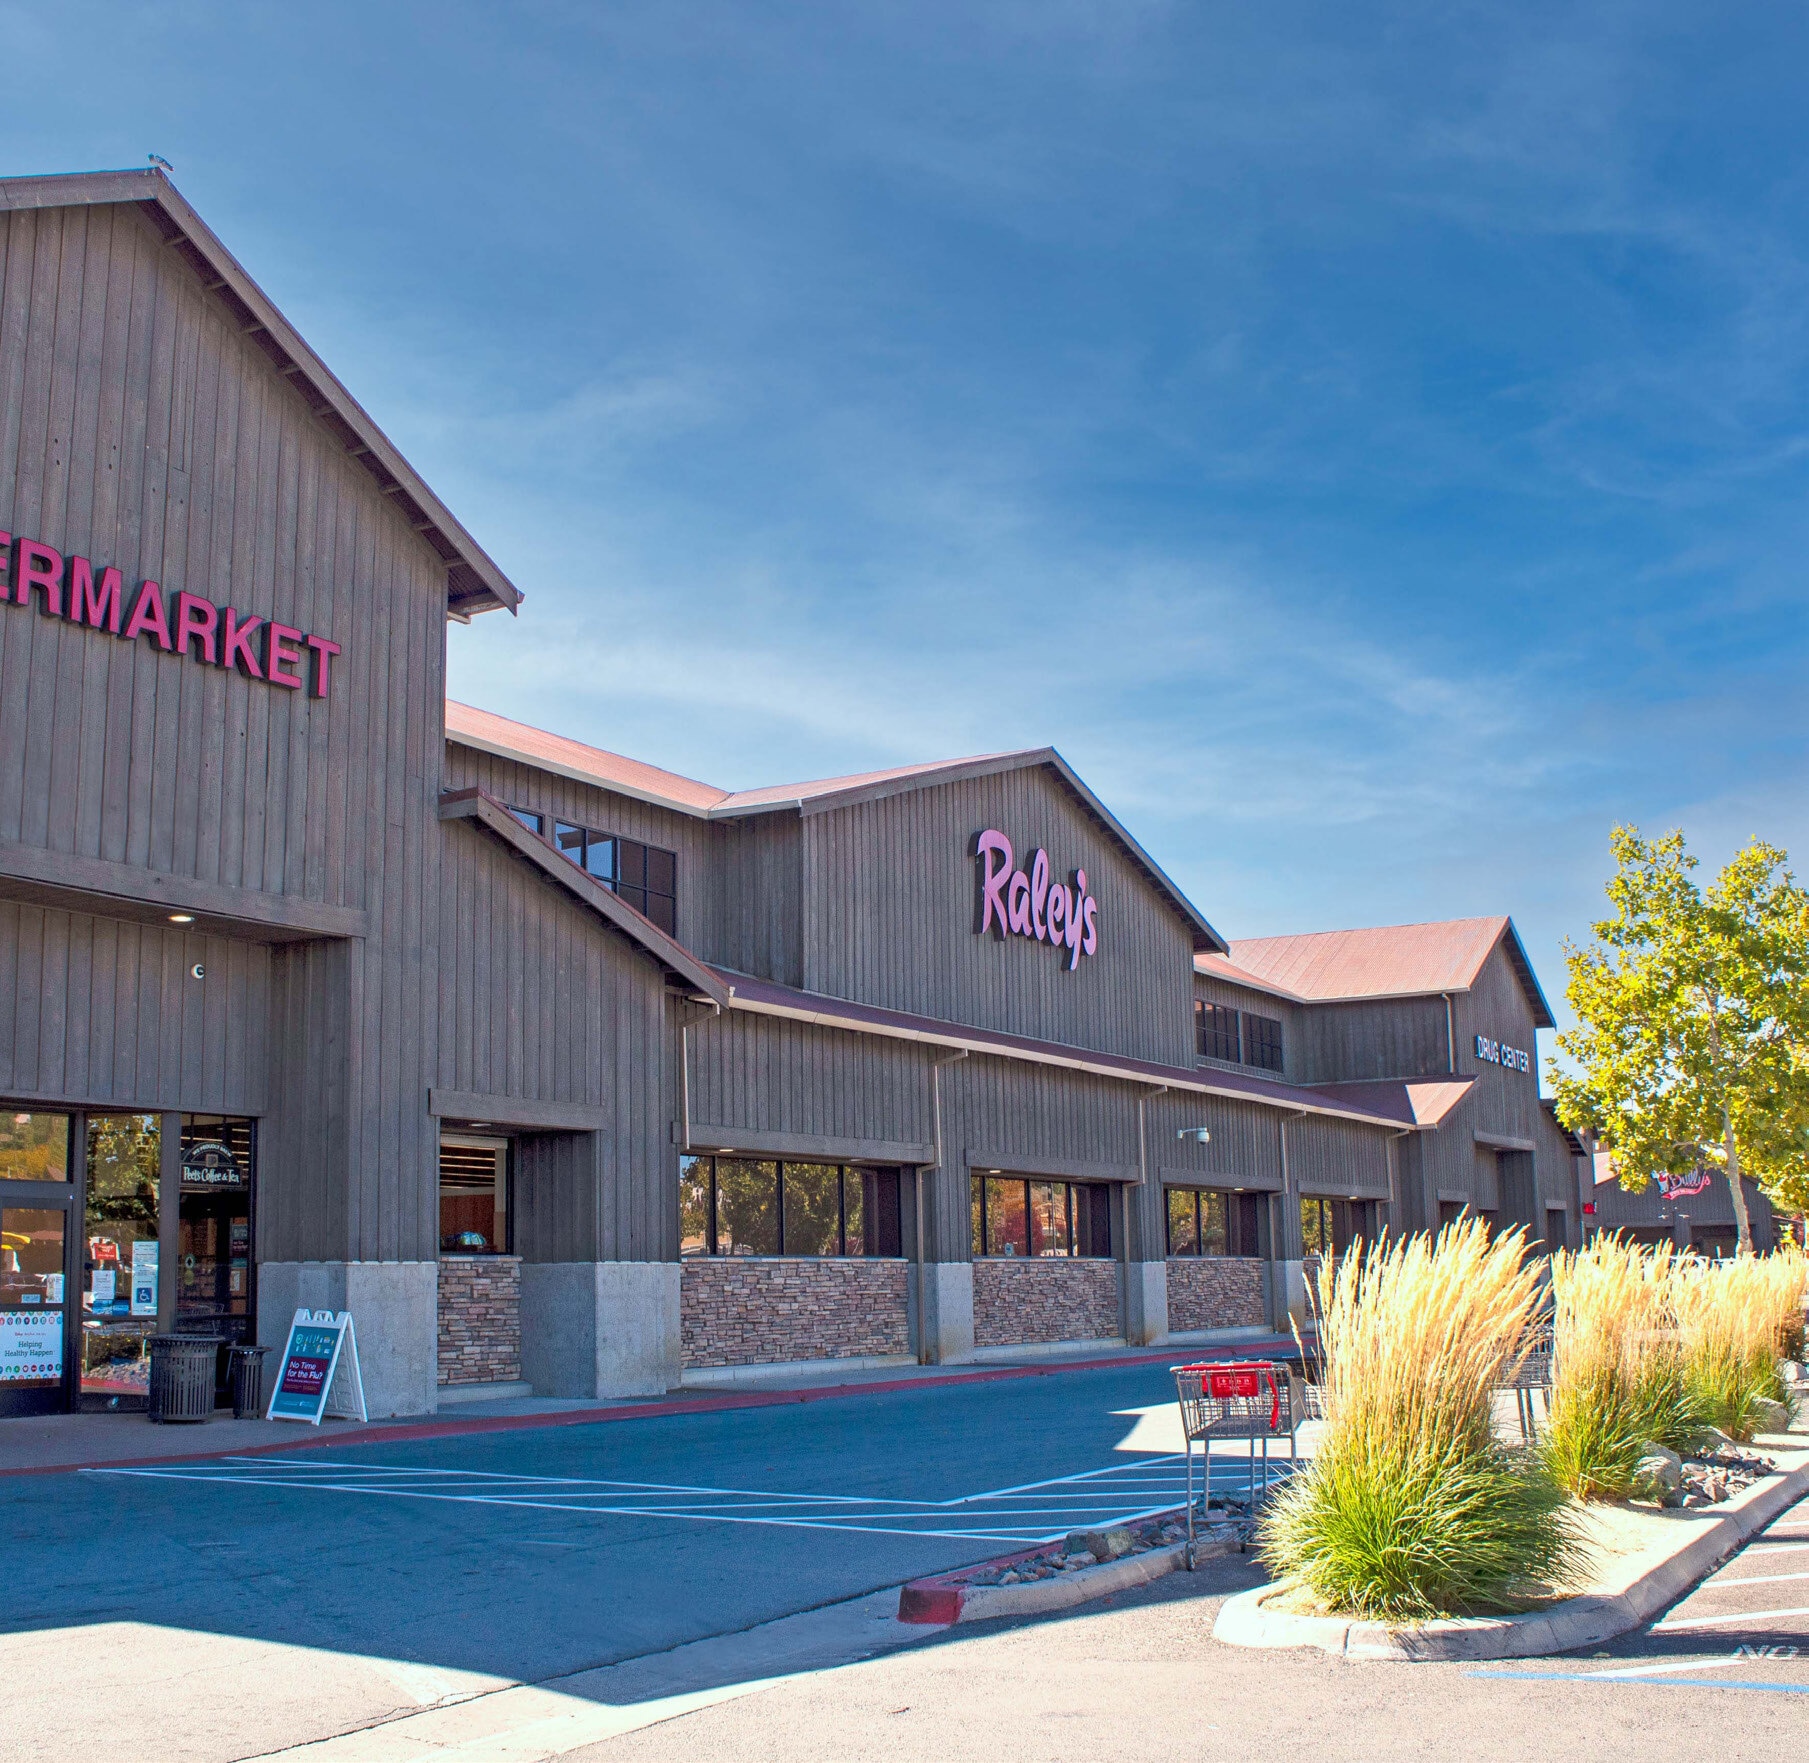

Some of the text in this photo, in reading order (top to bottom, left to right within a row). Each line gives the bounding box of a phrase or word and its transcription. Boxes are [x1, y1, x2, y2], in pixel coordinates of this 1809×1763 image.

[975, 829, 1098, 972] Raley's
[1476, 1035, 1529, 1073] DRUG CENTER
[201, 1168, 222, 1183] Coffee
[222, 1172, 228, 1181] &
[227, 1169, 240, 1183] Tea
[18, 1341, 43, 1349] Helping
[290, 1361, 317, 1370] No Time
[288, 1369, 323, 1380] for the Flu?
